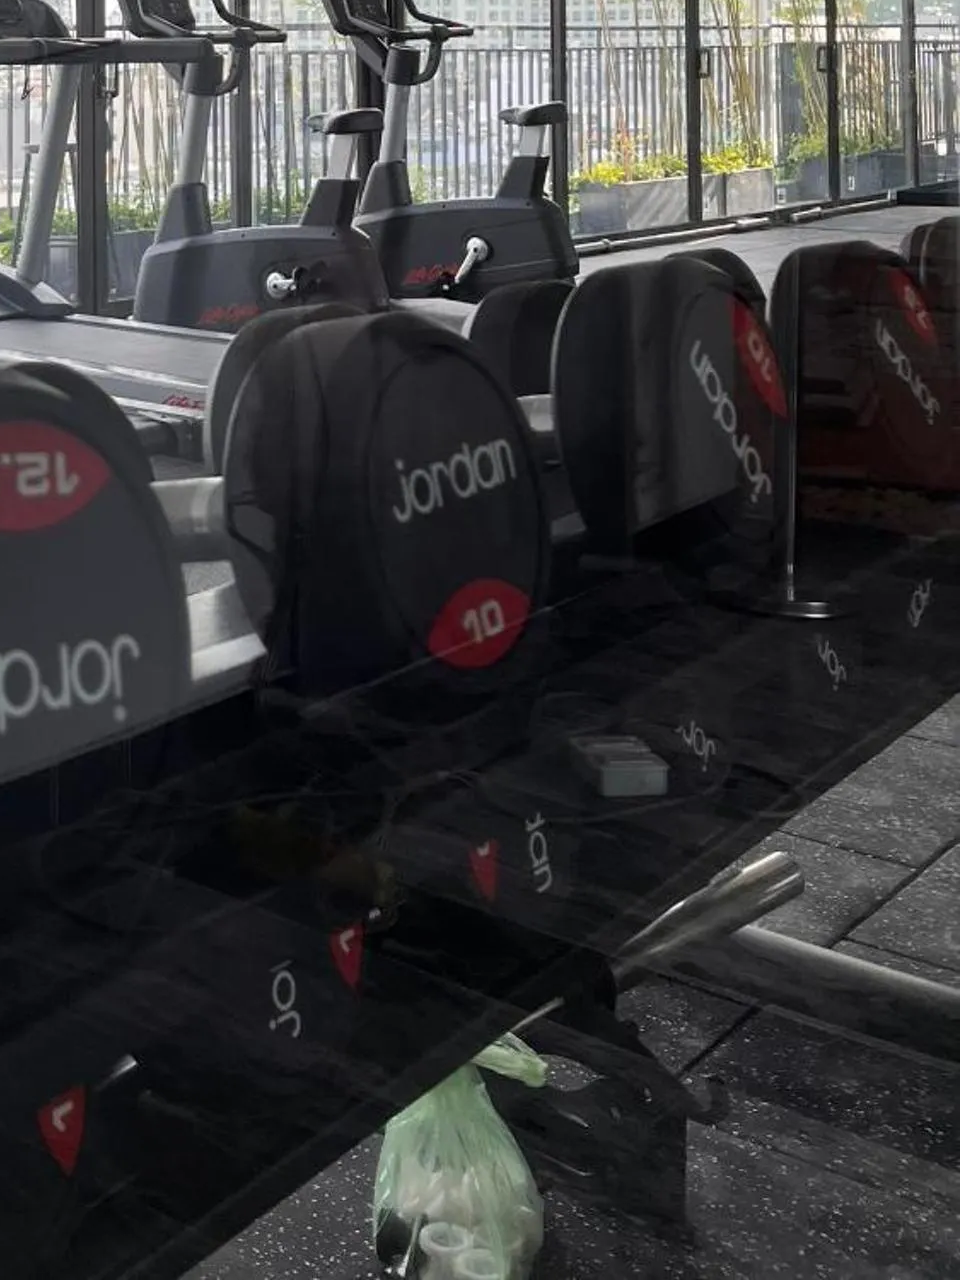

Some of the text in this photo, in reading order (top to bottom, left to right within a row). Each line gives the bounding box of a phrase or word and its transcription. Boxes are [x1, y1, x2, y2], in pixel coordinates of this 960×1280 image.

[875, 316, 942, 427] jordan
[689, 338, 773, 505] jordan
[391, 437, 518, 524] jordan
[461, 597, 507, 645] 10
